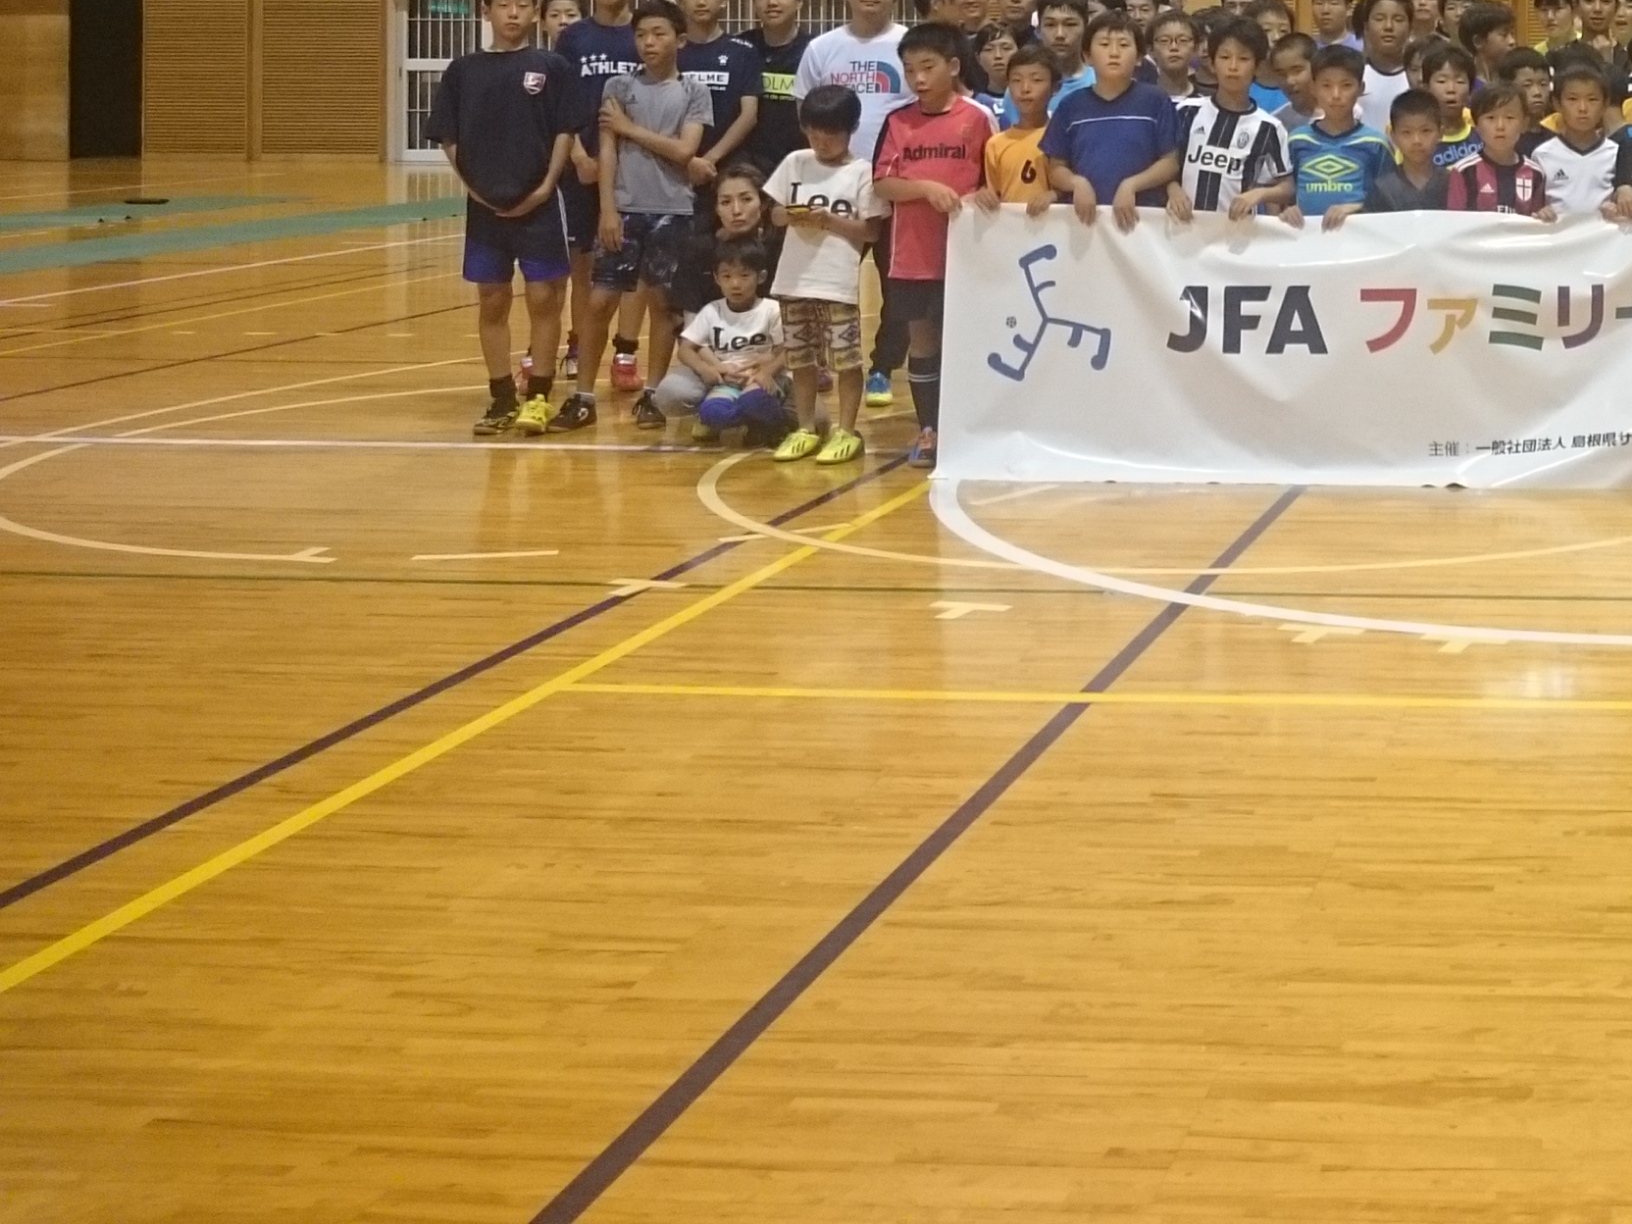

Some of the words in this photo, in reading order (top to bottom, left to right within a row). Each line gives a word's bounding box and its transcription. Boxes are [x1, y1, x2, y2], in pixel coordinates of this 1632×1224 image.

[850, 61, 876, 72] THE
[830, 72, 875, 85] NORTH
[848, 82, 875, 94] ACE
[902, 143, 967, 162] Admiral
[1187, 145, 1243, 175] Jeep
[1020, 159, 1038, 184] 6
[1306, 181, 1353, 193] umbro
[790, 181, 851, 216] Lee
[1166, 284, 1330, 355] JFA
[713, 325, 767, 352] Lee
